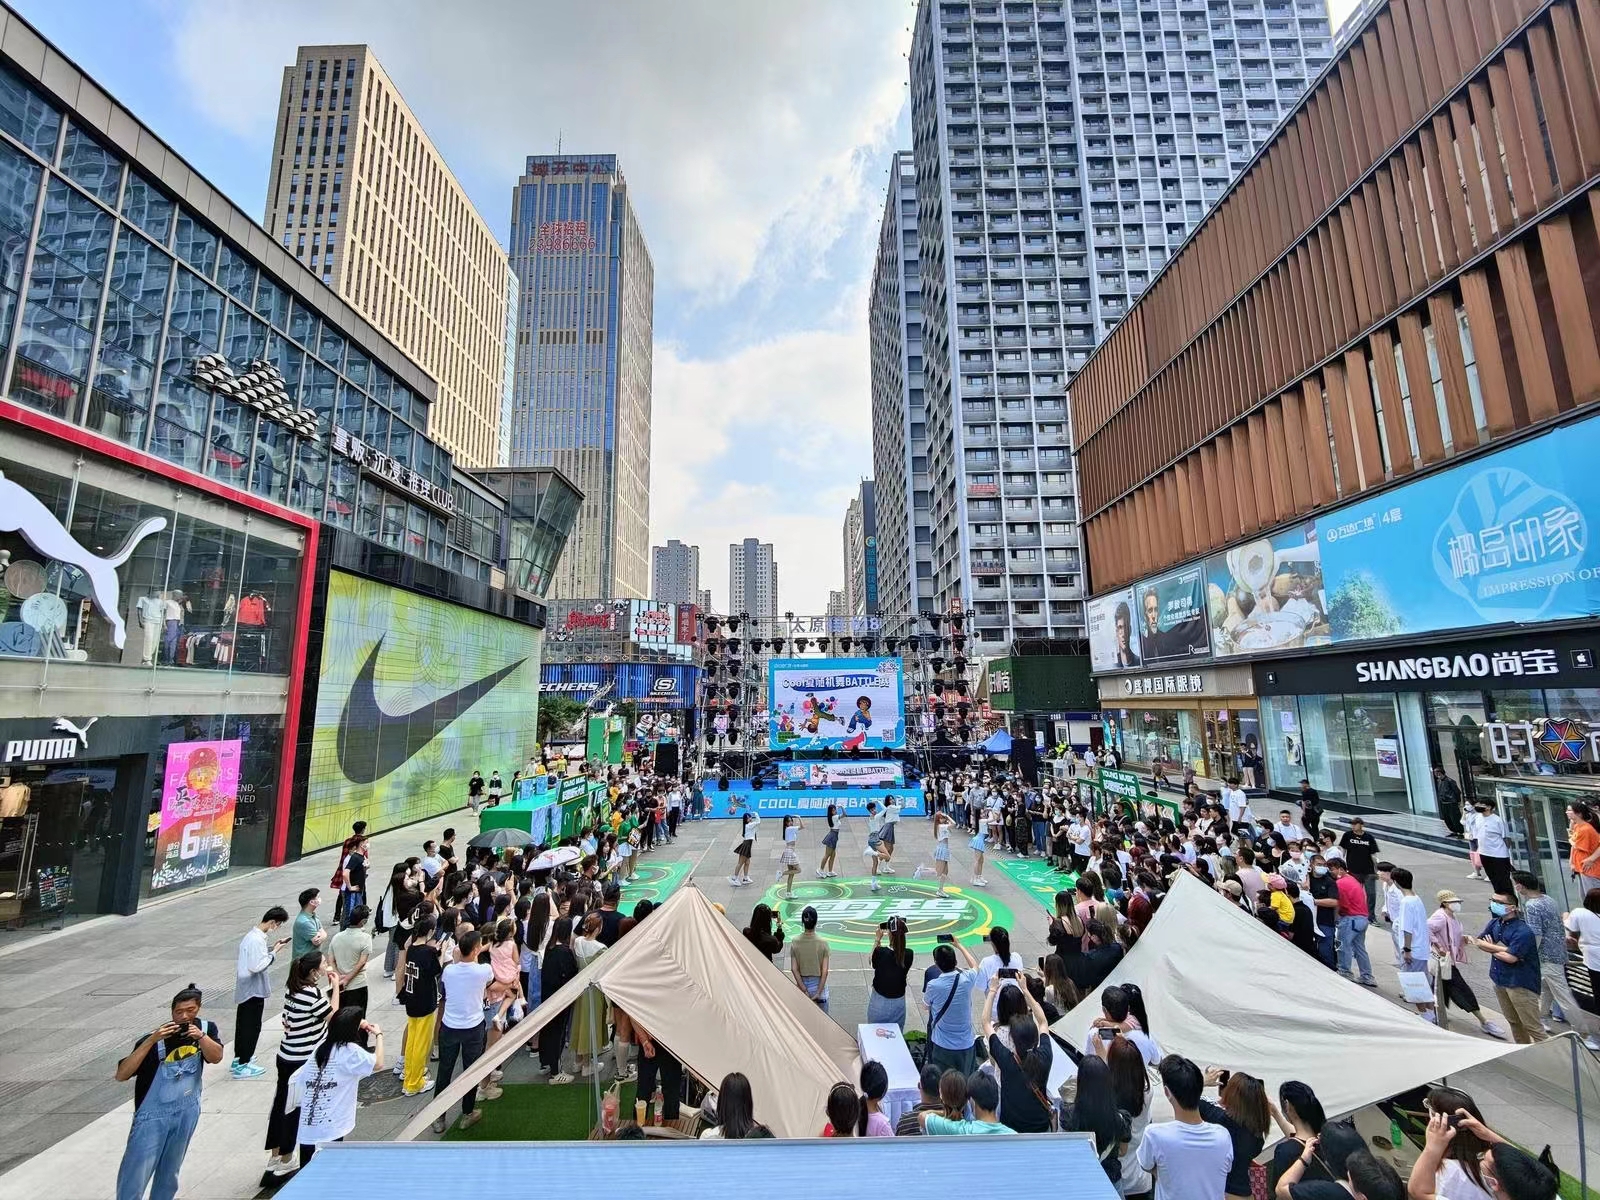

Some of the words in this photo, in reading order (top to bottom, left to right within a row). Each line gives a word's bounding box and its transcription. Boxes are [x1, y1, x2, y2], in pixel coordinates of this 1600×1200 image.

[539, 220, 587, 236] 全球招租
[529, 236, 596, 252] 23986666
[1338, 516, 1374, 535] 万达广场
[1382, 507, 1403, 524] 4层
[1483, 571, 1577, 598] IMPRESSION
[538, 682, 599, 692] ECHERS
[1133, 674, 1204, 695] 盛视国际眼镜
[5, 738, 77, 762] PUMA
[180, 821, 202, 860] 6
